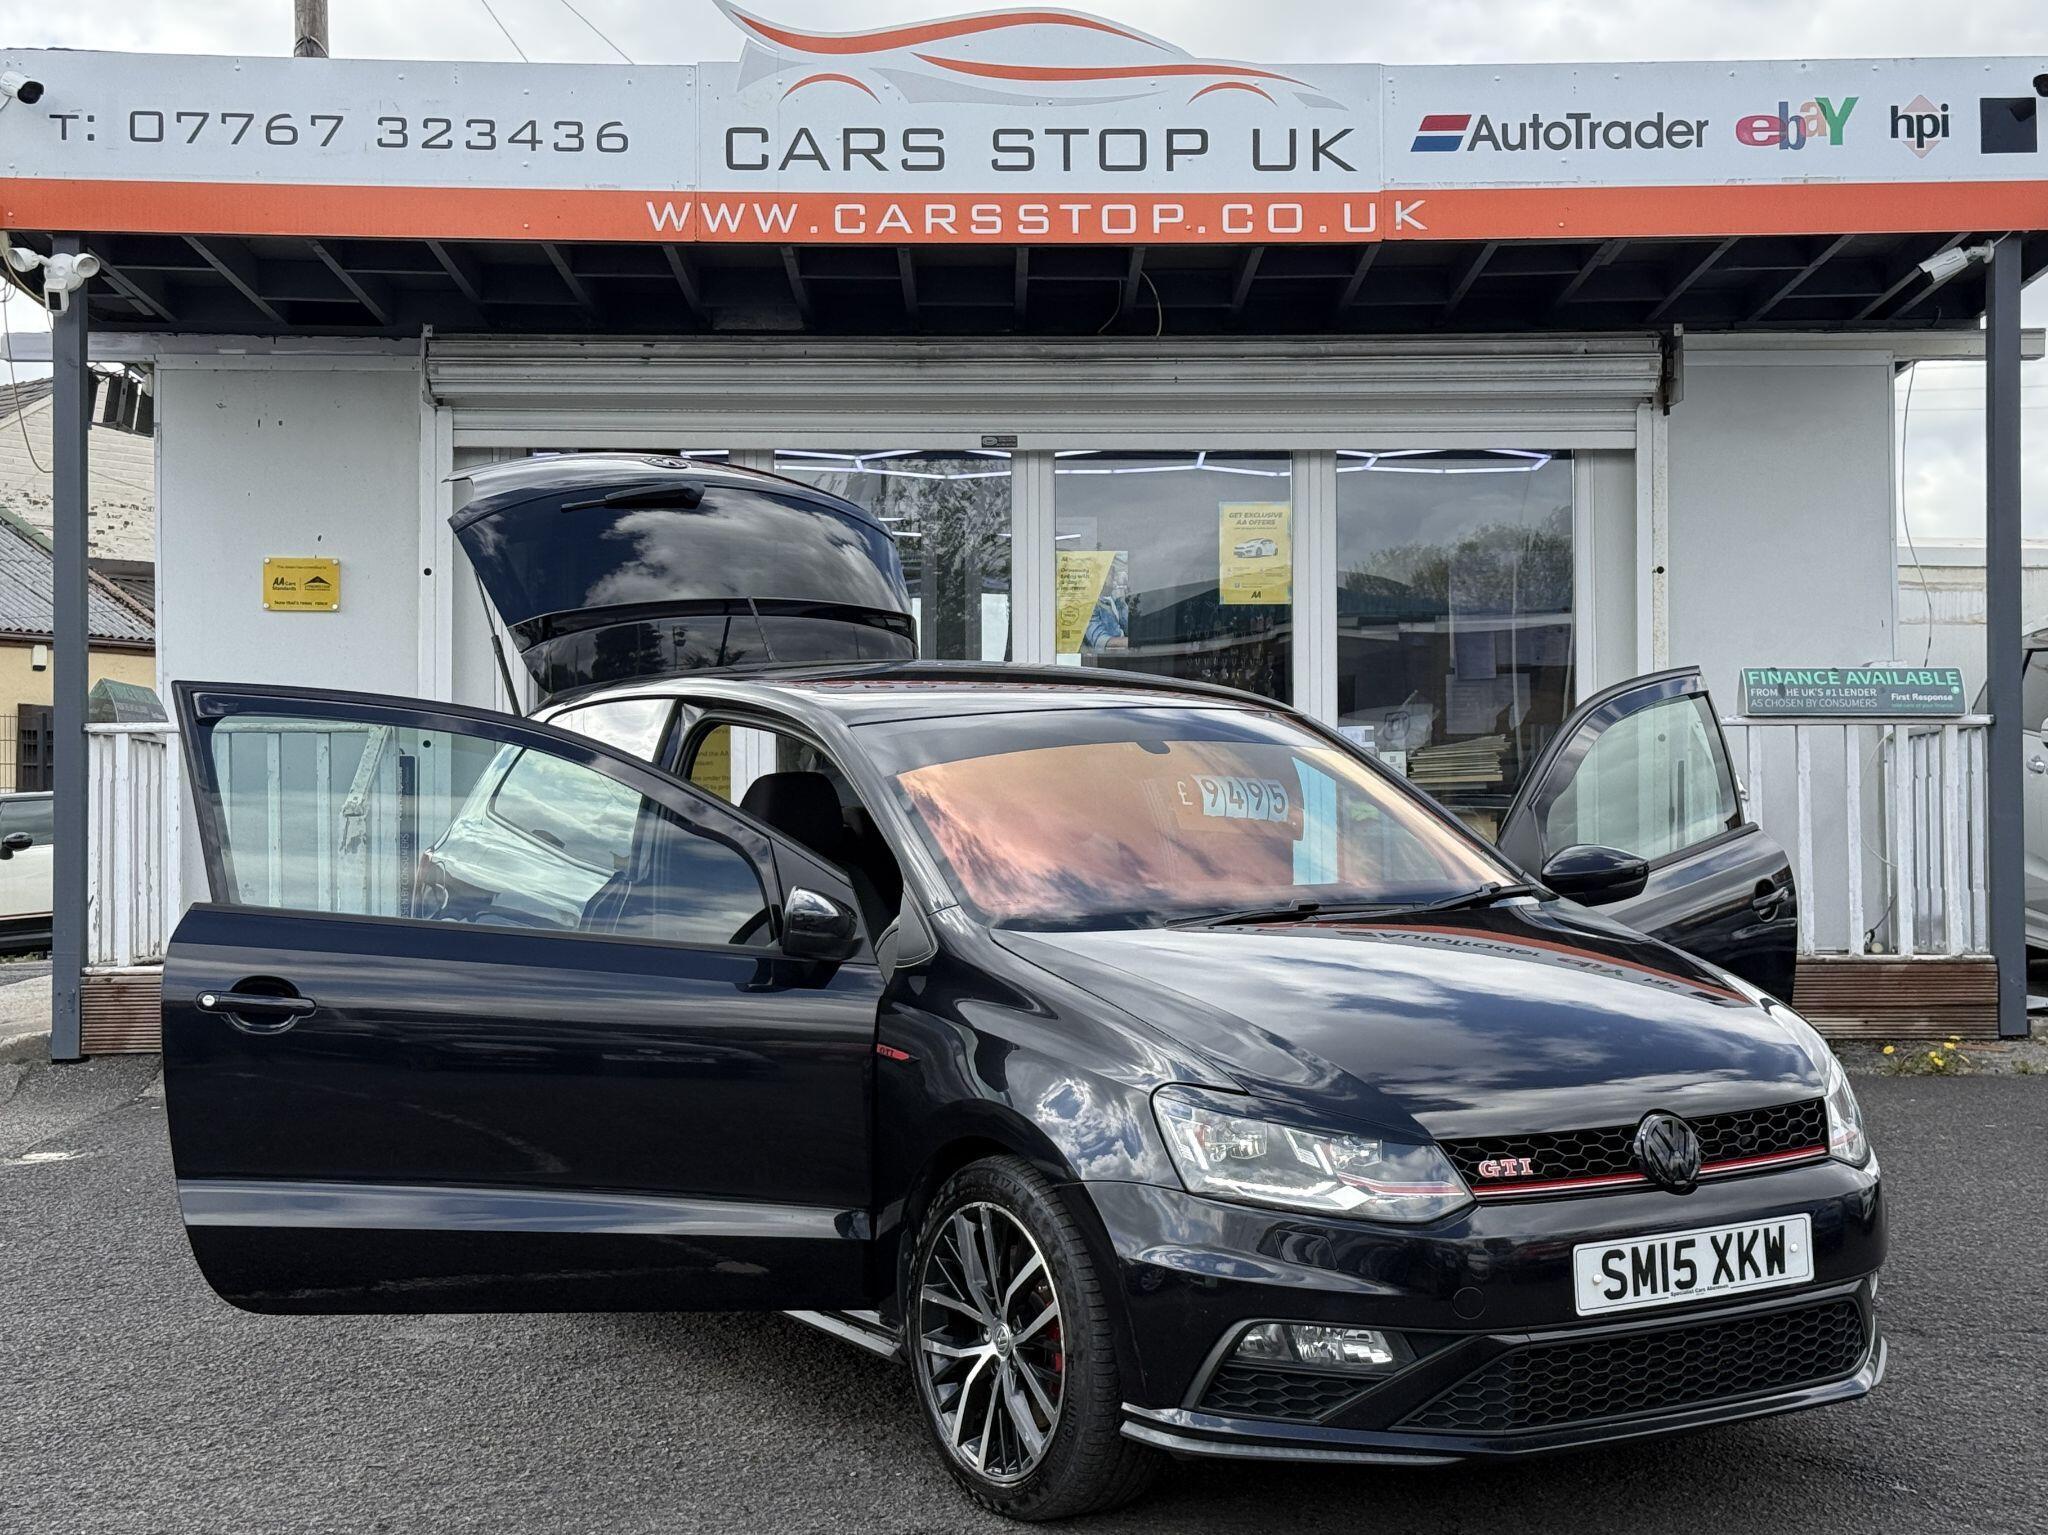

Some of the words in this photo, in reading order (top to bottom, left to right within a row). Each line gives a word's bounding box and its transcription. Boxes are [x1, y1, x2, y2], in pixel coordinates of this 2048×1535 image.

[48, 113, 95, 142] T:
[129, 110, 344, 147] 07767
[376, 116, 629, 153] 323436
[1467, 112, 1709, 152] AutoTrader
[1890, 103, 1950, 149] hpi
[725, 126, 945, 172] CARS
[991, 128, 1209, 172] STOP
[1252, 128, 1358, 172] UK
[647, 200, 1428, 234] WWW.CARSSTOP.CO.UK
[1228, 511, 1243, 519] GET
[1244, 511, 1283, 519] EXCLUSIVE
[1250, 590, 1262, 599] AA
[1747, 671, 1841, 685] FINANCE
[1846, 671, 1960, 686] AVAILABLE
[1750, 687, 1778, 697] FROM
[1780, 687, 1800, 697] HE
[1801, 687, 1824, 697] UK'S
[1839, 687, 1878, 698] LENDER
[1751, 698, 1764, 708] AS
[1764, 698, 1804, 708] CHOSEN
[1805, 698, 1818, 708] BY
[1818, 698, 1878, 708] CONSUMERS
[1891, 692, 1910, 701] First
[1911, 692, 1953, 703] Response
[1478, 1157, 1535, 1178] GTI
[1601, 1238, 1698, 1301] SM15
[1710, 1224, 1786, 1286] XKW
